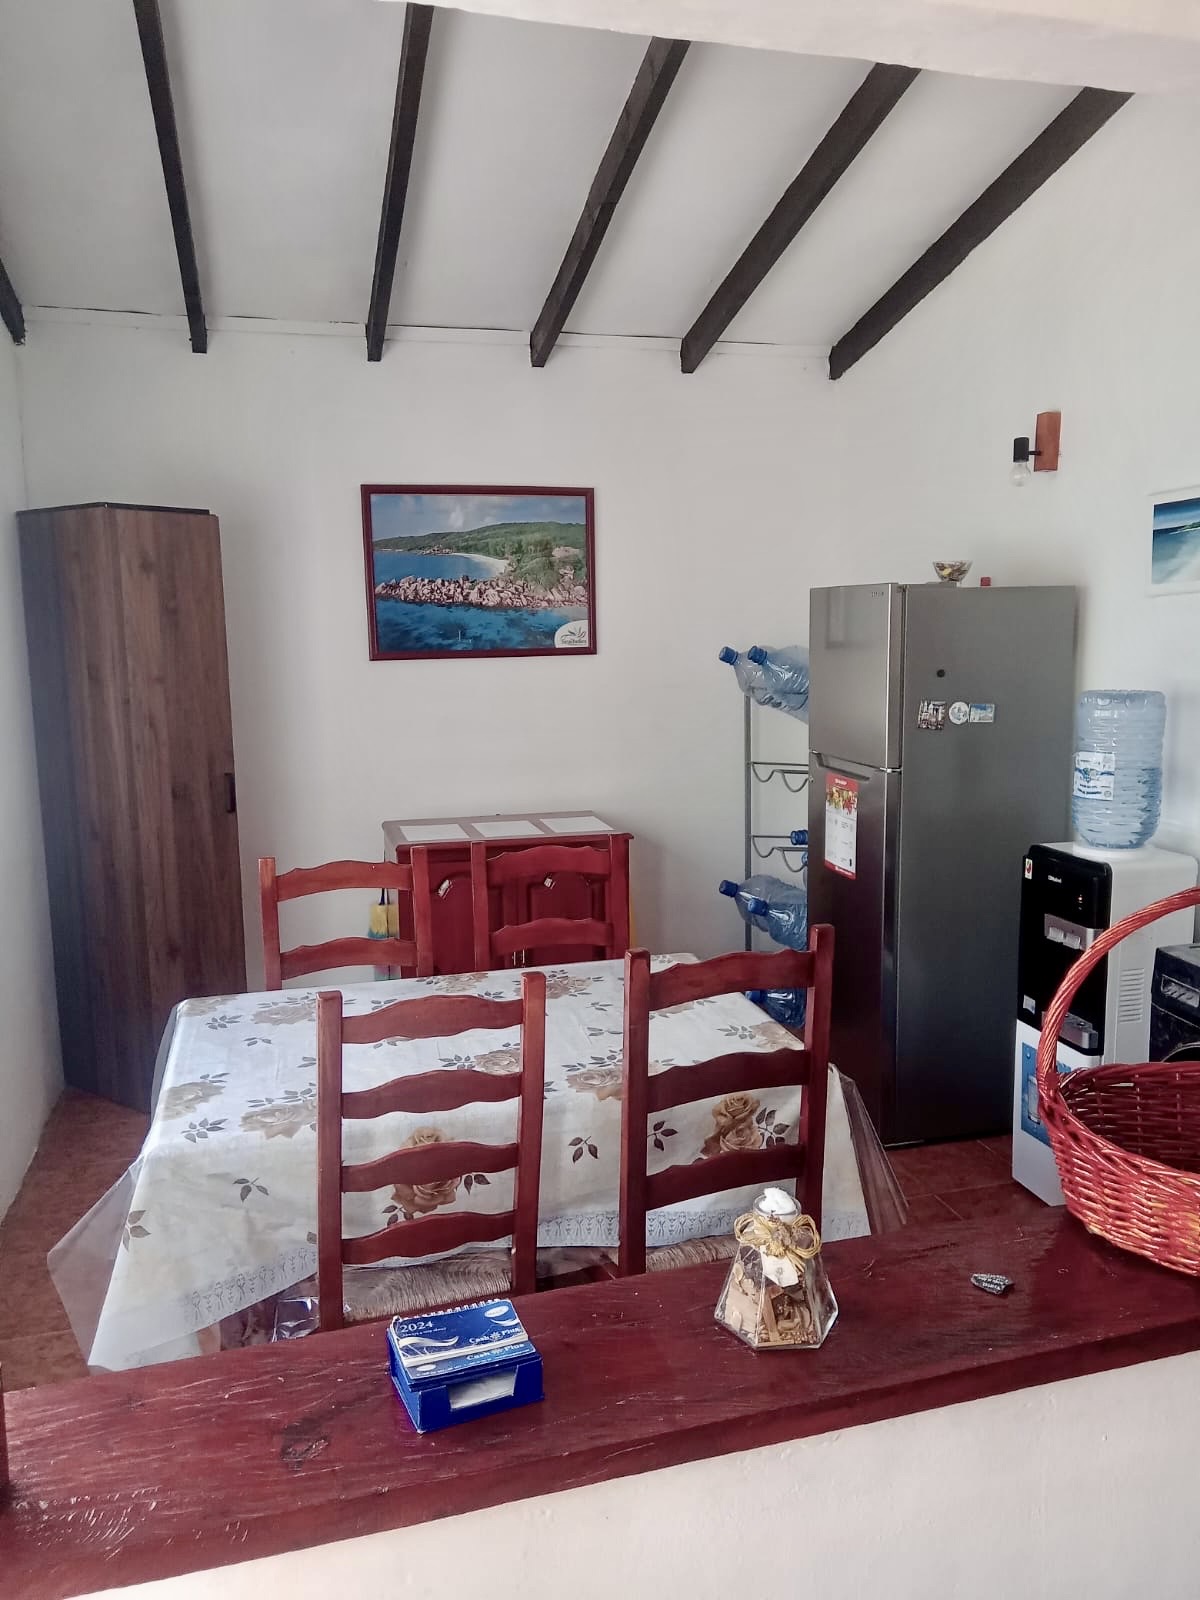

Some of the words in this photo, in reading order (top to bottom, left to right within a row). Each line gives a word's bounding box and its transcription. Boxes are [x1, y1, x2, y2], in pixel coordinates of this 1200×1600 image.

[400, 1321, 433, 1333] 2024
[469, 1335, 490, 1344] Cash
[501, 1327, 521, 1336] Plus
[466, 1351, 490, 1361] Cash
